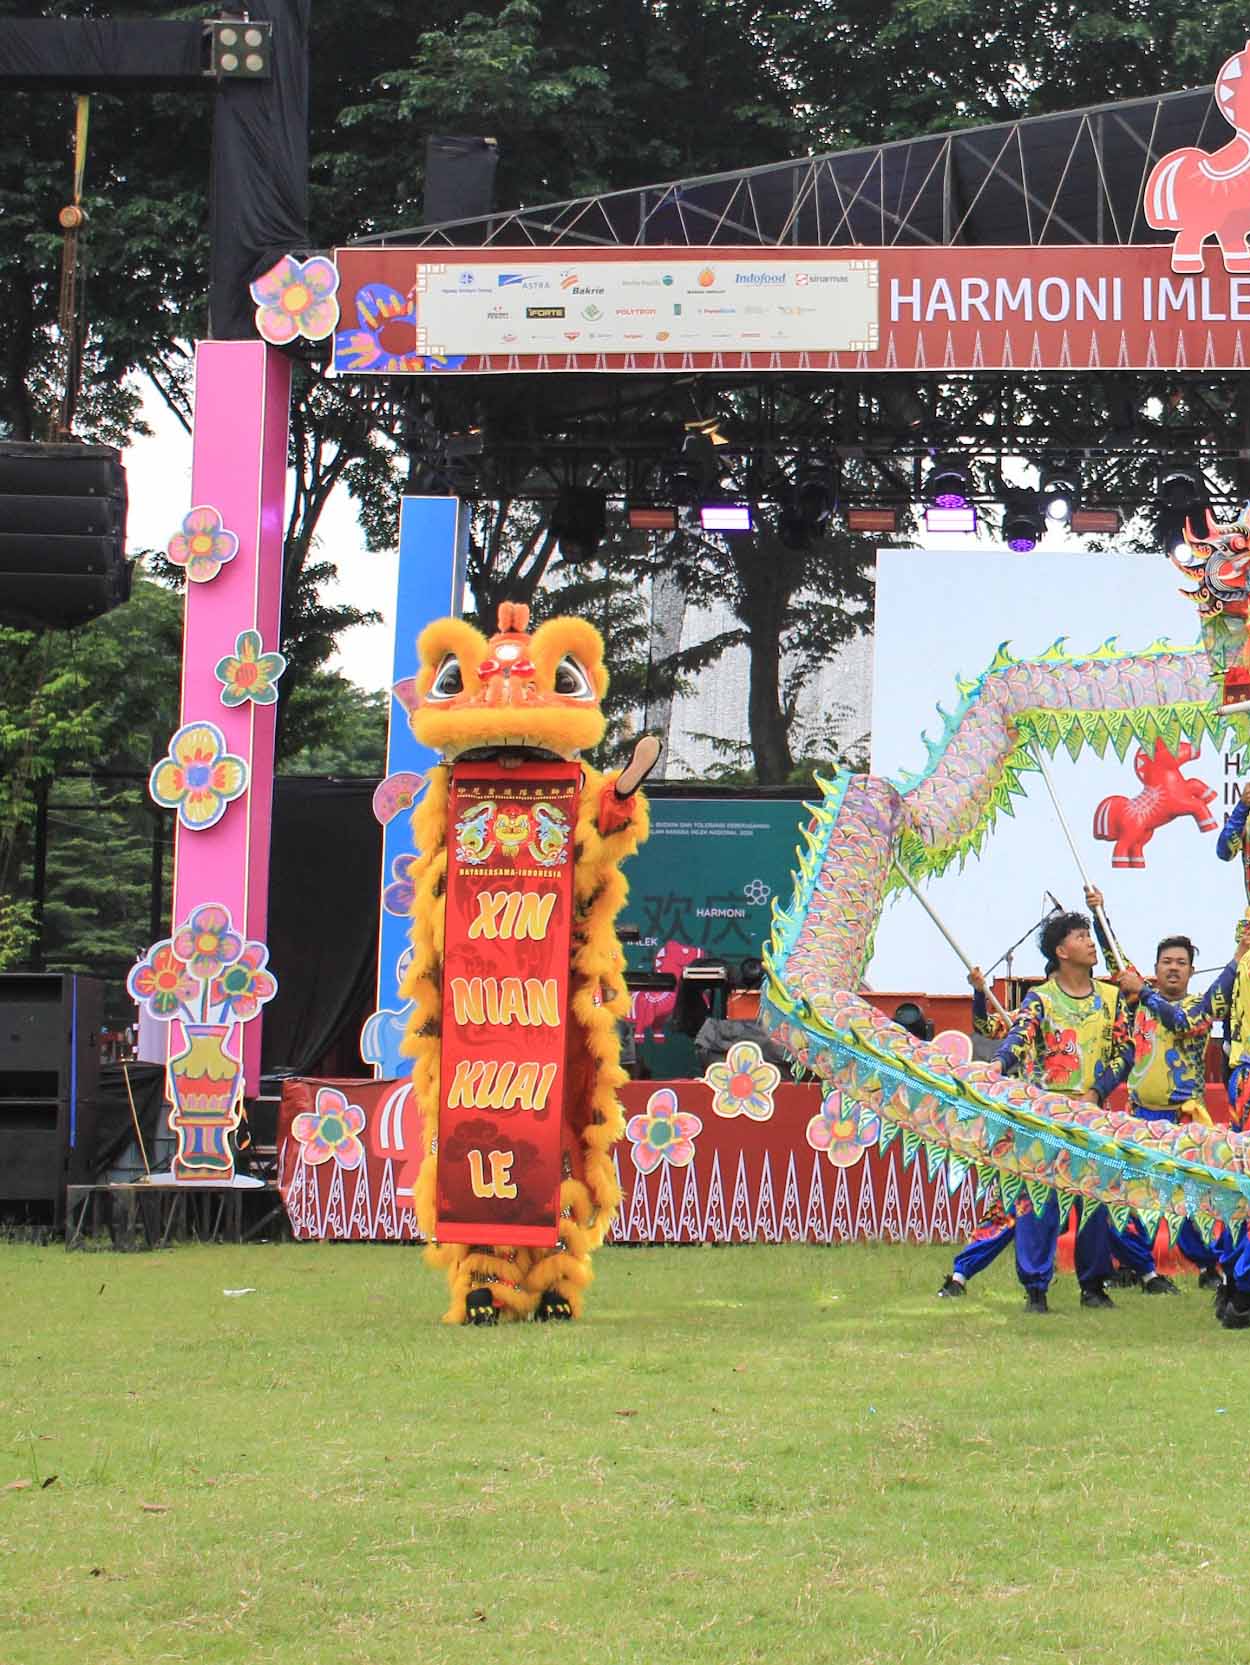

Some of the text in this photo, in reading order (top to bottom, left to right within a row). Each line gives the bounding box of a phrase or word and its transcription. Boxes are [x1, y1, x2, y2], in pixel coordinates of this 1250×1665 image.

[522, 281, 551, 289] ASTRA
[572, 286, 605, 295] Bakrie
[735, 273, 786, 286] Indofood
[809, 275, 848, 283] sinarmas
[889, 276, 1121, 322] HARMONI
[468, 891, 557, 941] XIN
[696, 908, 746, 918] HARMONI
[451, 977, 560, 1027] NIAN
[447, 1060, 557, 1110] KUAI
[467, 1149, 518, 1200] LE
